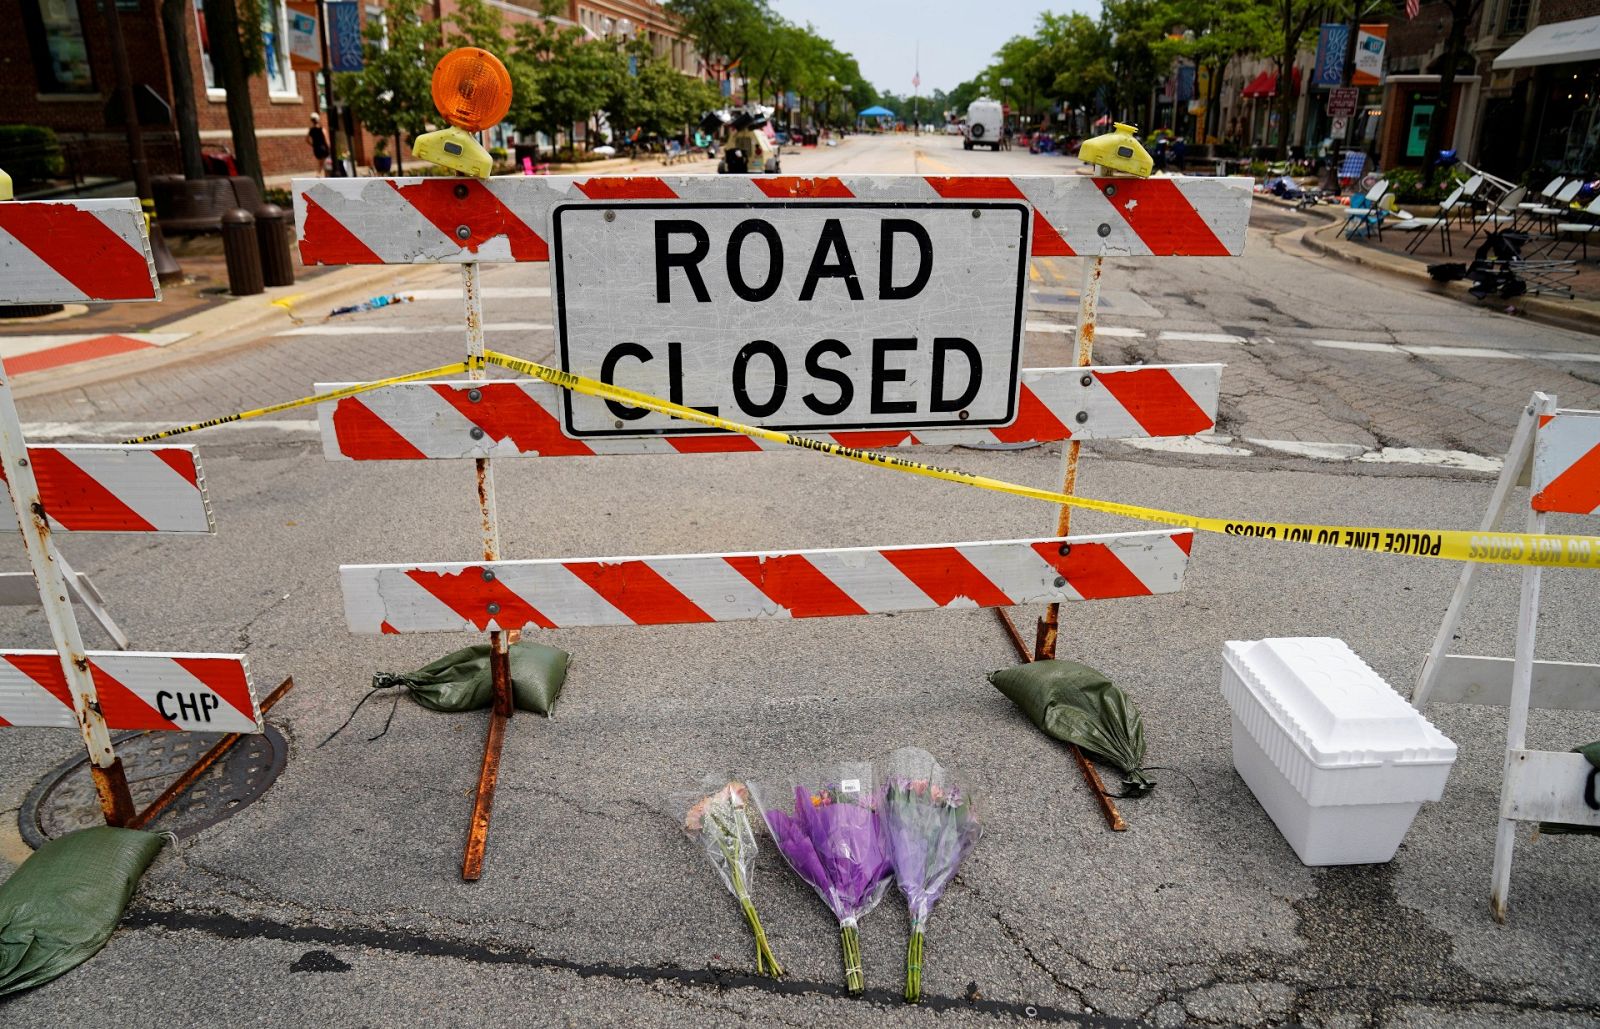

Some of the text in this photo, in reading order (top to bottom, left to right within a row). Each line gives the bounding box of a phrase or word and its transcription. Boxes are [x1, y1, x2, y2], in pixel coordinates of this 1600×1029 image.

[654, 218, 934, 304] ROAD
[600, 337, 983, 421] CLOSED
[1345, 531, 1380, 551] LINE
[1383, 533, 1442, 556] POLICE
[1468, 535, 1525, 561] CROSS
[1527, 538, 1563, 564] NOT
[1567, 540, 1591, 564] DO
[157, 691, 219, 722] CHP
